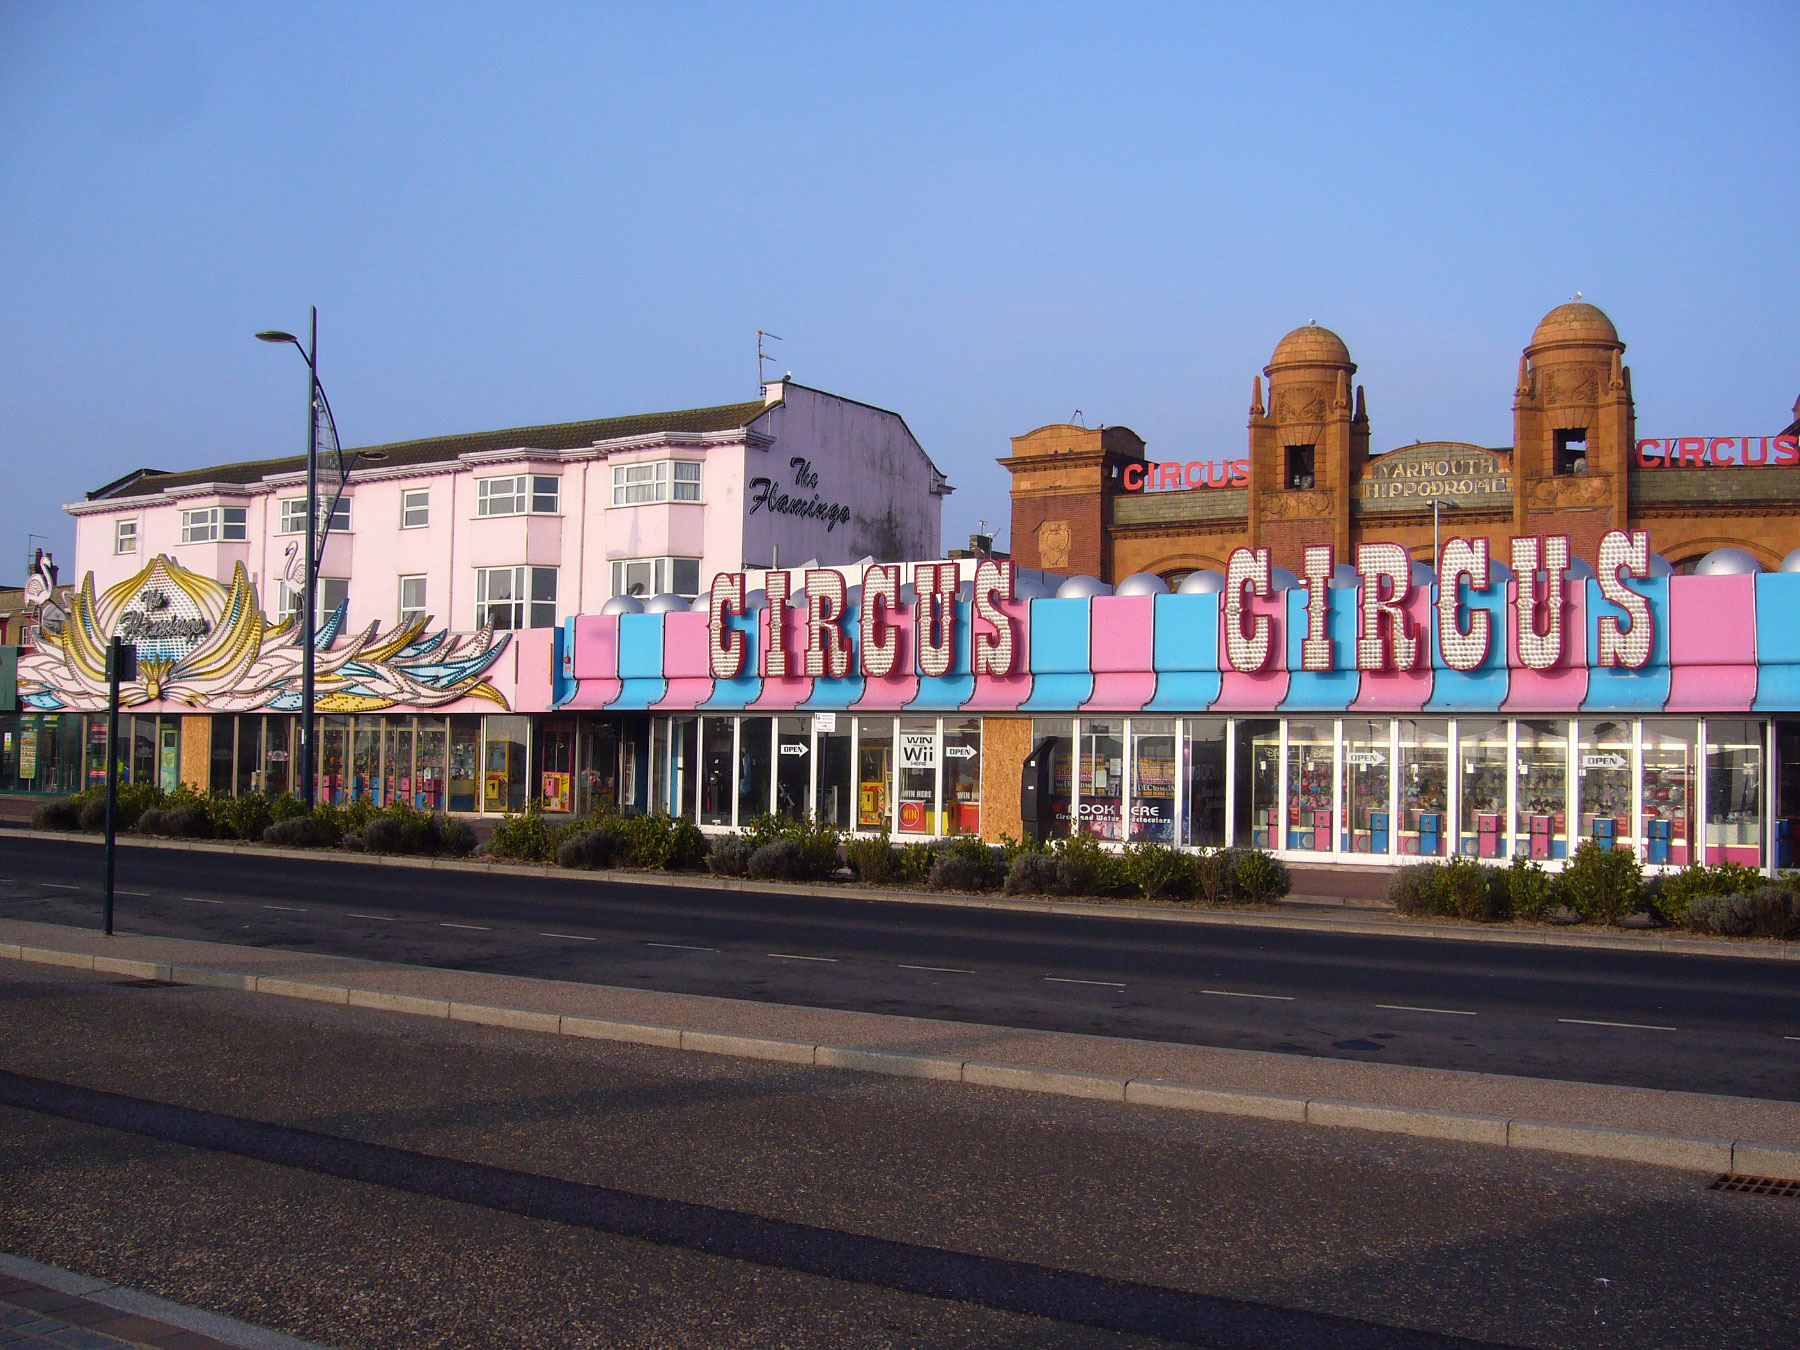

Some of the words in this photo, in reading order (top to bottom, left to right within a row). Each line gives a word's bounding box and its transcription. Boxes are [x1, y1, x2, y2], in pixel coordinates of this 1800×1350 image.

[1636, 435, 1800, 467] CIRCUS
[790, 456, 818, 488] The
[1123, 459, 1249, 491] CIRCUS
[1380, 458, 1494, 479] YARMOUTH
[1365, 477, 1507, 498] HIPPODROME
[749, 477, 850, 532] Flamingo
[140, 588, 170, 612] The
[1220, 528, 1655, 673] CIRCUS
[119, 609, 209, 646] Flamingo
[705, 559, 1016, 680] CIRCUS
[906, 736, 933, 744] WIN
[903, 746, 933, 762] Wii
[949, 748, 971, 756] OPEN
[1350, 753, 1378, 762] OPEN
[1587, 757, 1618, 765] OPEN
[903, 790, 915, 798] WIN
[916, 790, 932, 798] HERE
[956, 791, 970, 799] WIN
[902, 809, 918, 820] WIN
[1067, 804, 1115, 815] OOK
[1119, 805, 1160, 817] ERE
